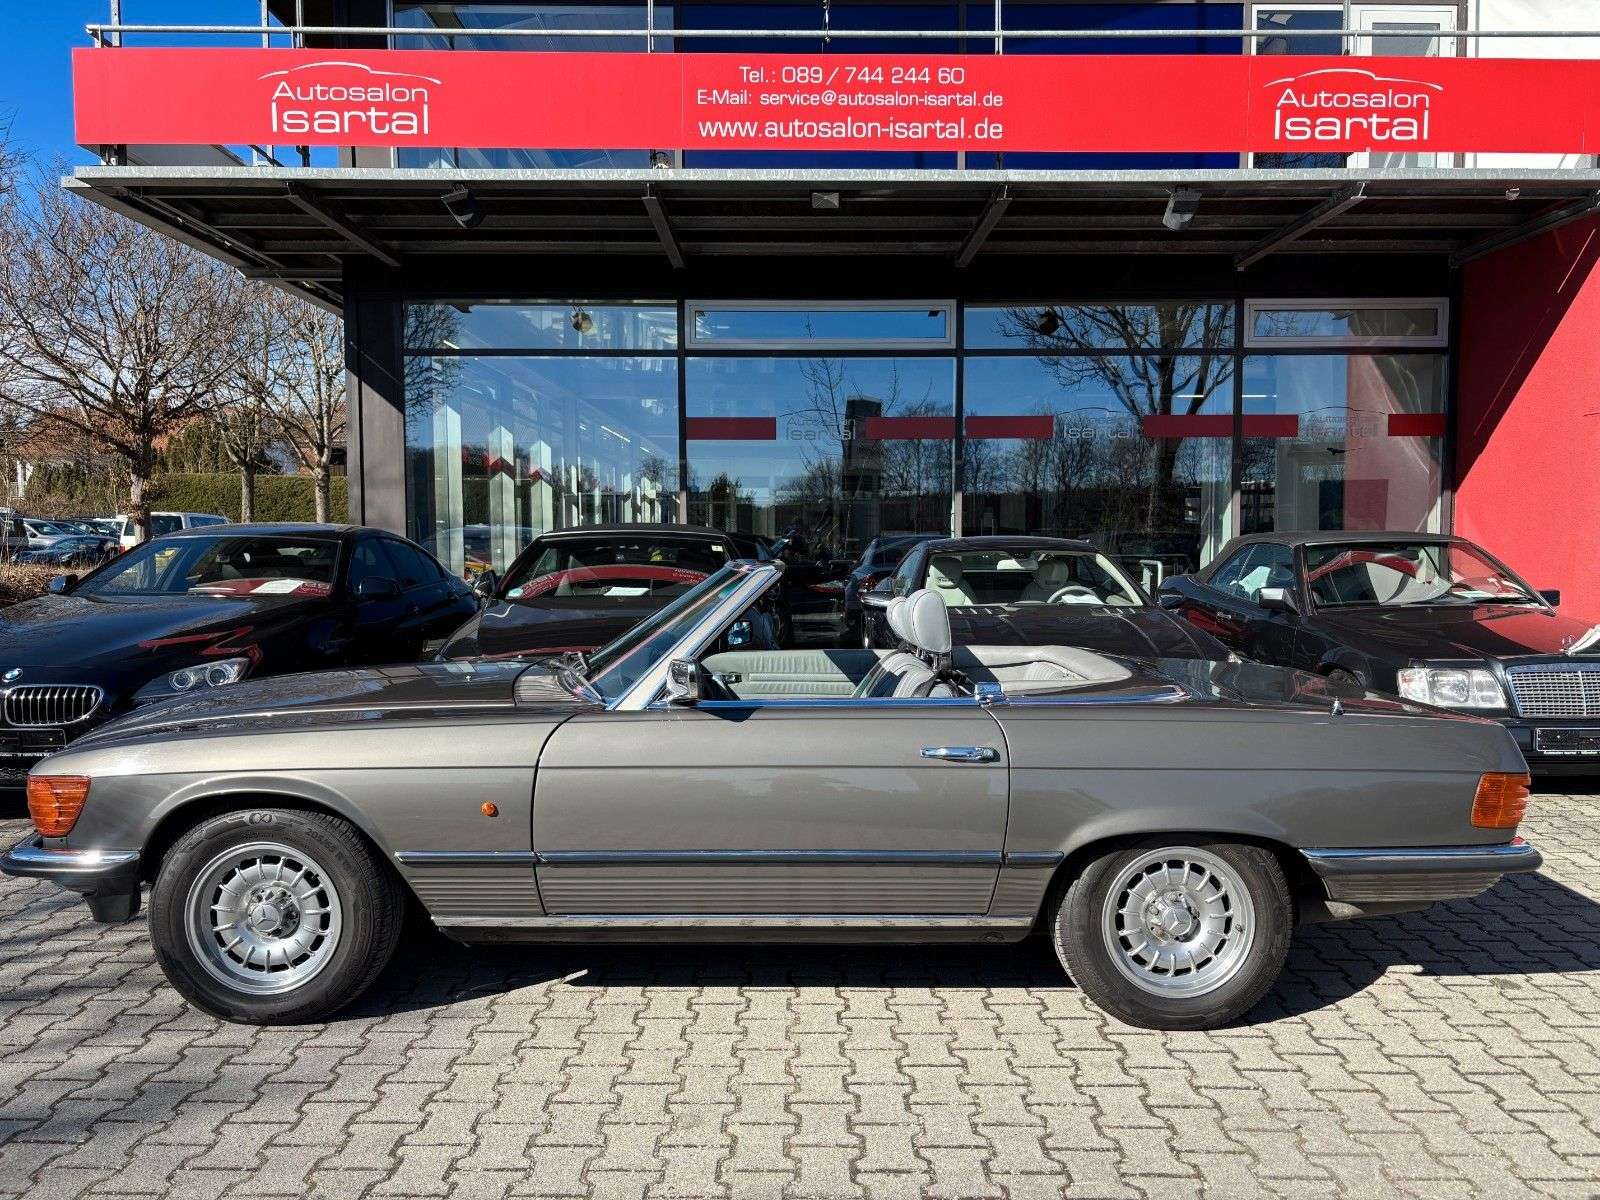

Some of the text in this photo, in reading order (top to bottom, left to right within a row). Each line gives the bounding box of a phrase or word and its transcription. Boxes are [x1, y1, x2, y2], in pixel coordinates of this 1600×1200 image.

[738, 66, 777, 84] Tel.:
[781, 66, 823, 84] 089
[844, 66, 884, 84] 744
[891, 66, 931, 84] 244
[937, 67, 965, 85] 60
[272, 81, 428, 103] Autosalon
[697, 89, 1003, 107] E-Mail: service@autosalon-isartal.de
[1276, 88, 1430, 108] Autosalon
[271, 102, 429, 135] Isartal
[698, 117, 1004, 140] www.autosalon-isartal.de
[1274, 109, 1430, 141] Isartal
